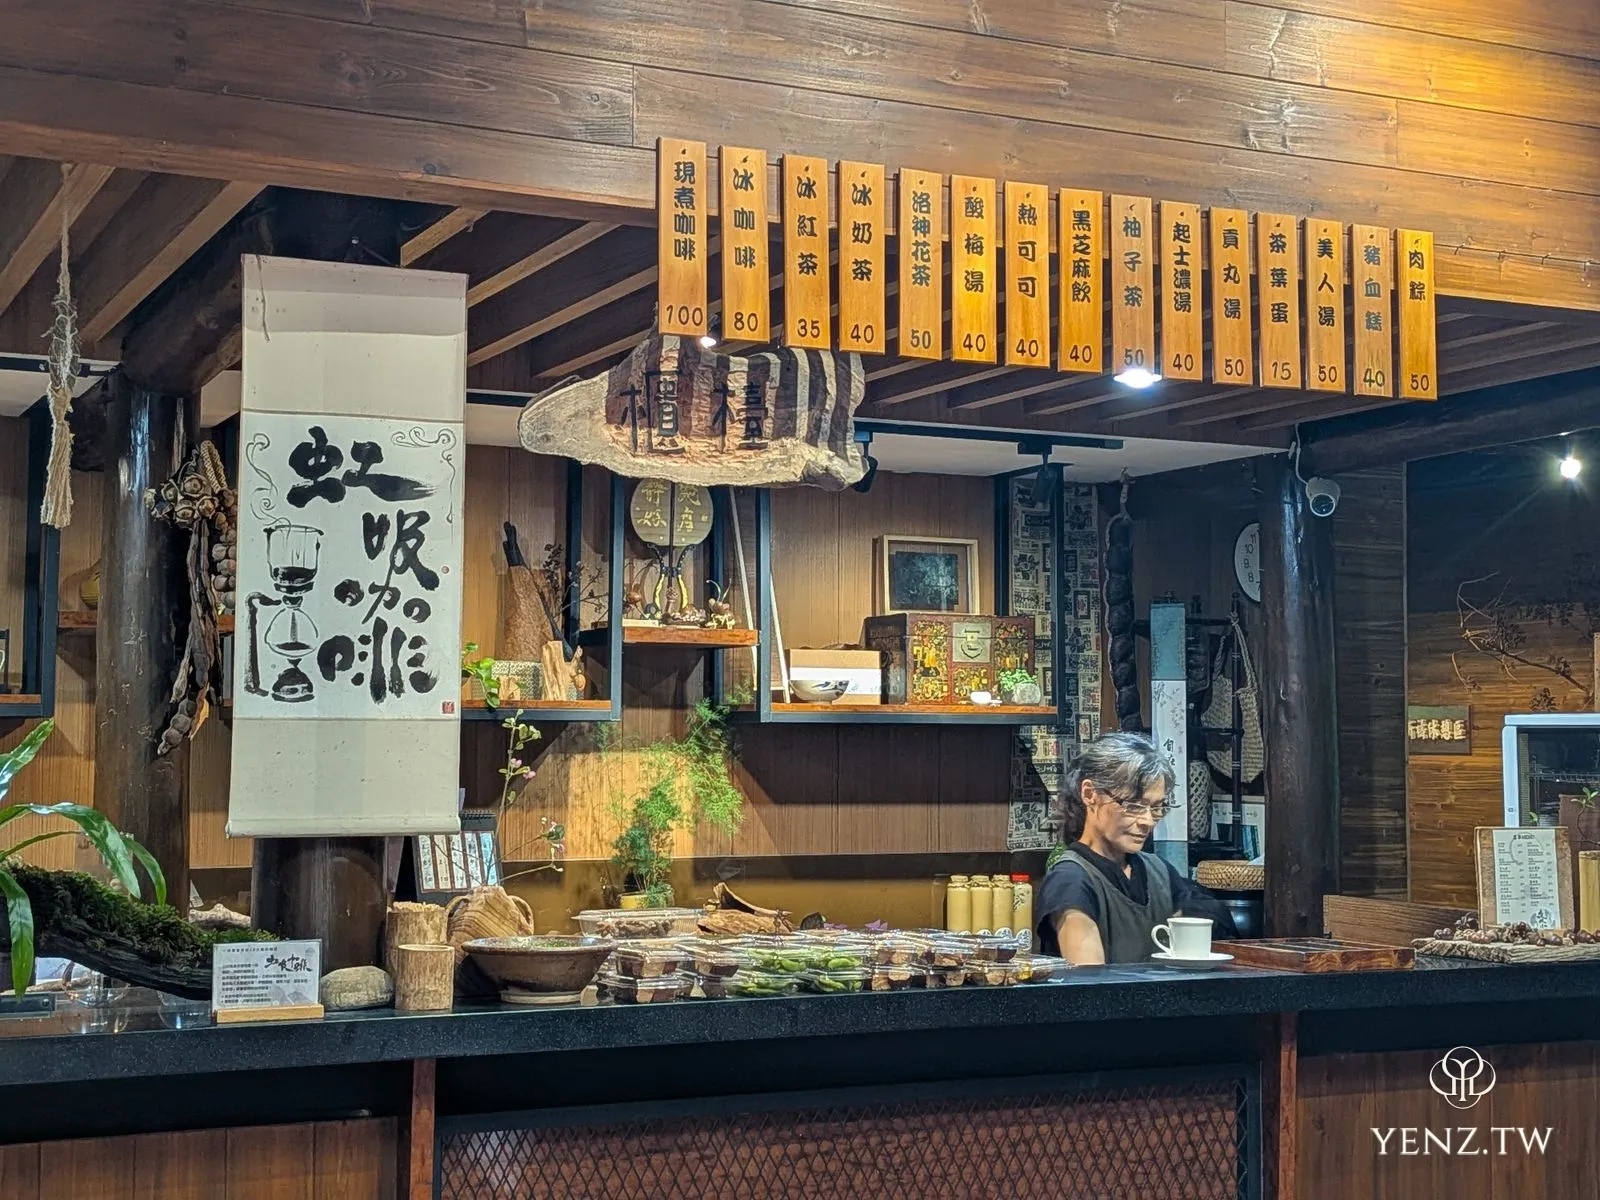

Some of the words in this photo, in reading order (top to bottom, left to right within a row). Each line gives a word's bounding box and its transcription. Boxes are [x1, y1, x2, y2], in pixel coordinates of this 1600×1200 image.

[673, 161, 696, 261] 現煮咖啡
[732, 167, 756, 269] 冰咖啡
[796, 175, 819, 276] 冰紅茶
[851, 182, 873, 282] 冰奶茶
[911, 190, 932, 288] 洛神花茶
[964, 196, 985, 294] 酸梅湯
[1017, 202, 1038, 299] 熱可可
[1071, 210, 1092, 304] 黑芝麻飲
[1122, 215, 1143, 308] 柚子茶
[1172, 221, 1192, 314] 起士濃湯
[1222, 228, 1242, 320] 貢丸湯
[1268, 232, 1289, 324] 茶葉蛋
[1316, 238, 1336, 328] 美人湯
[1364, 245, 1383, 332] 豬血糕
[1408, 249, 1426, 302] 肉粽
[666, 304, 704, 327] 100
[733, 311, 759, 332] 80
[797, 318, 821, 339] 35
[850, 323, 875, 344] 40
[910, 328, 932, 350] 50
[962, 333, 986, 353] 40
[1015, 338, 1039, 358] 40
[1069, 344, 1093, 364] 40
[1124, 348, 1144, 366] 50
[1172, 353, 1194, 372] 40
[1224, 358, 1245, 377] 50
[1271, 361, 1292, 381] 15
[1317, 364, 1338, 384] 50
[1362, 367, 1386, 388] 40
[1410, 373, 1430, 392] 50
[287, 426, 440, 704] 虹吸咖啡
